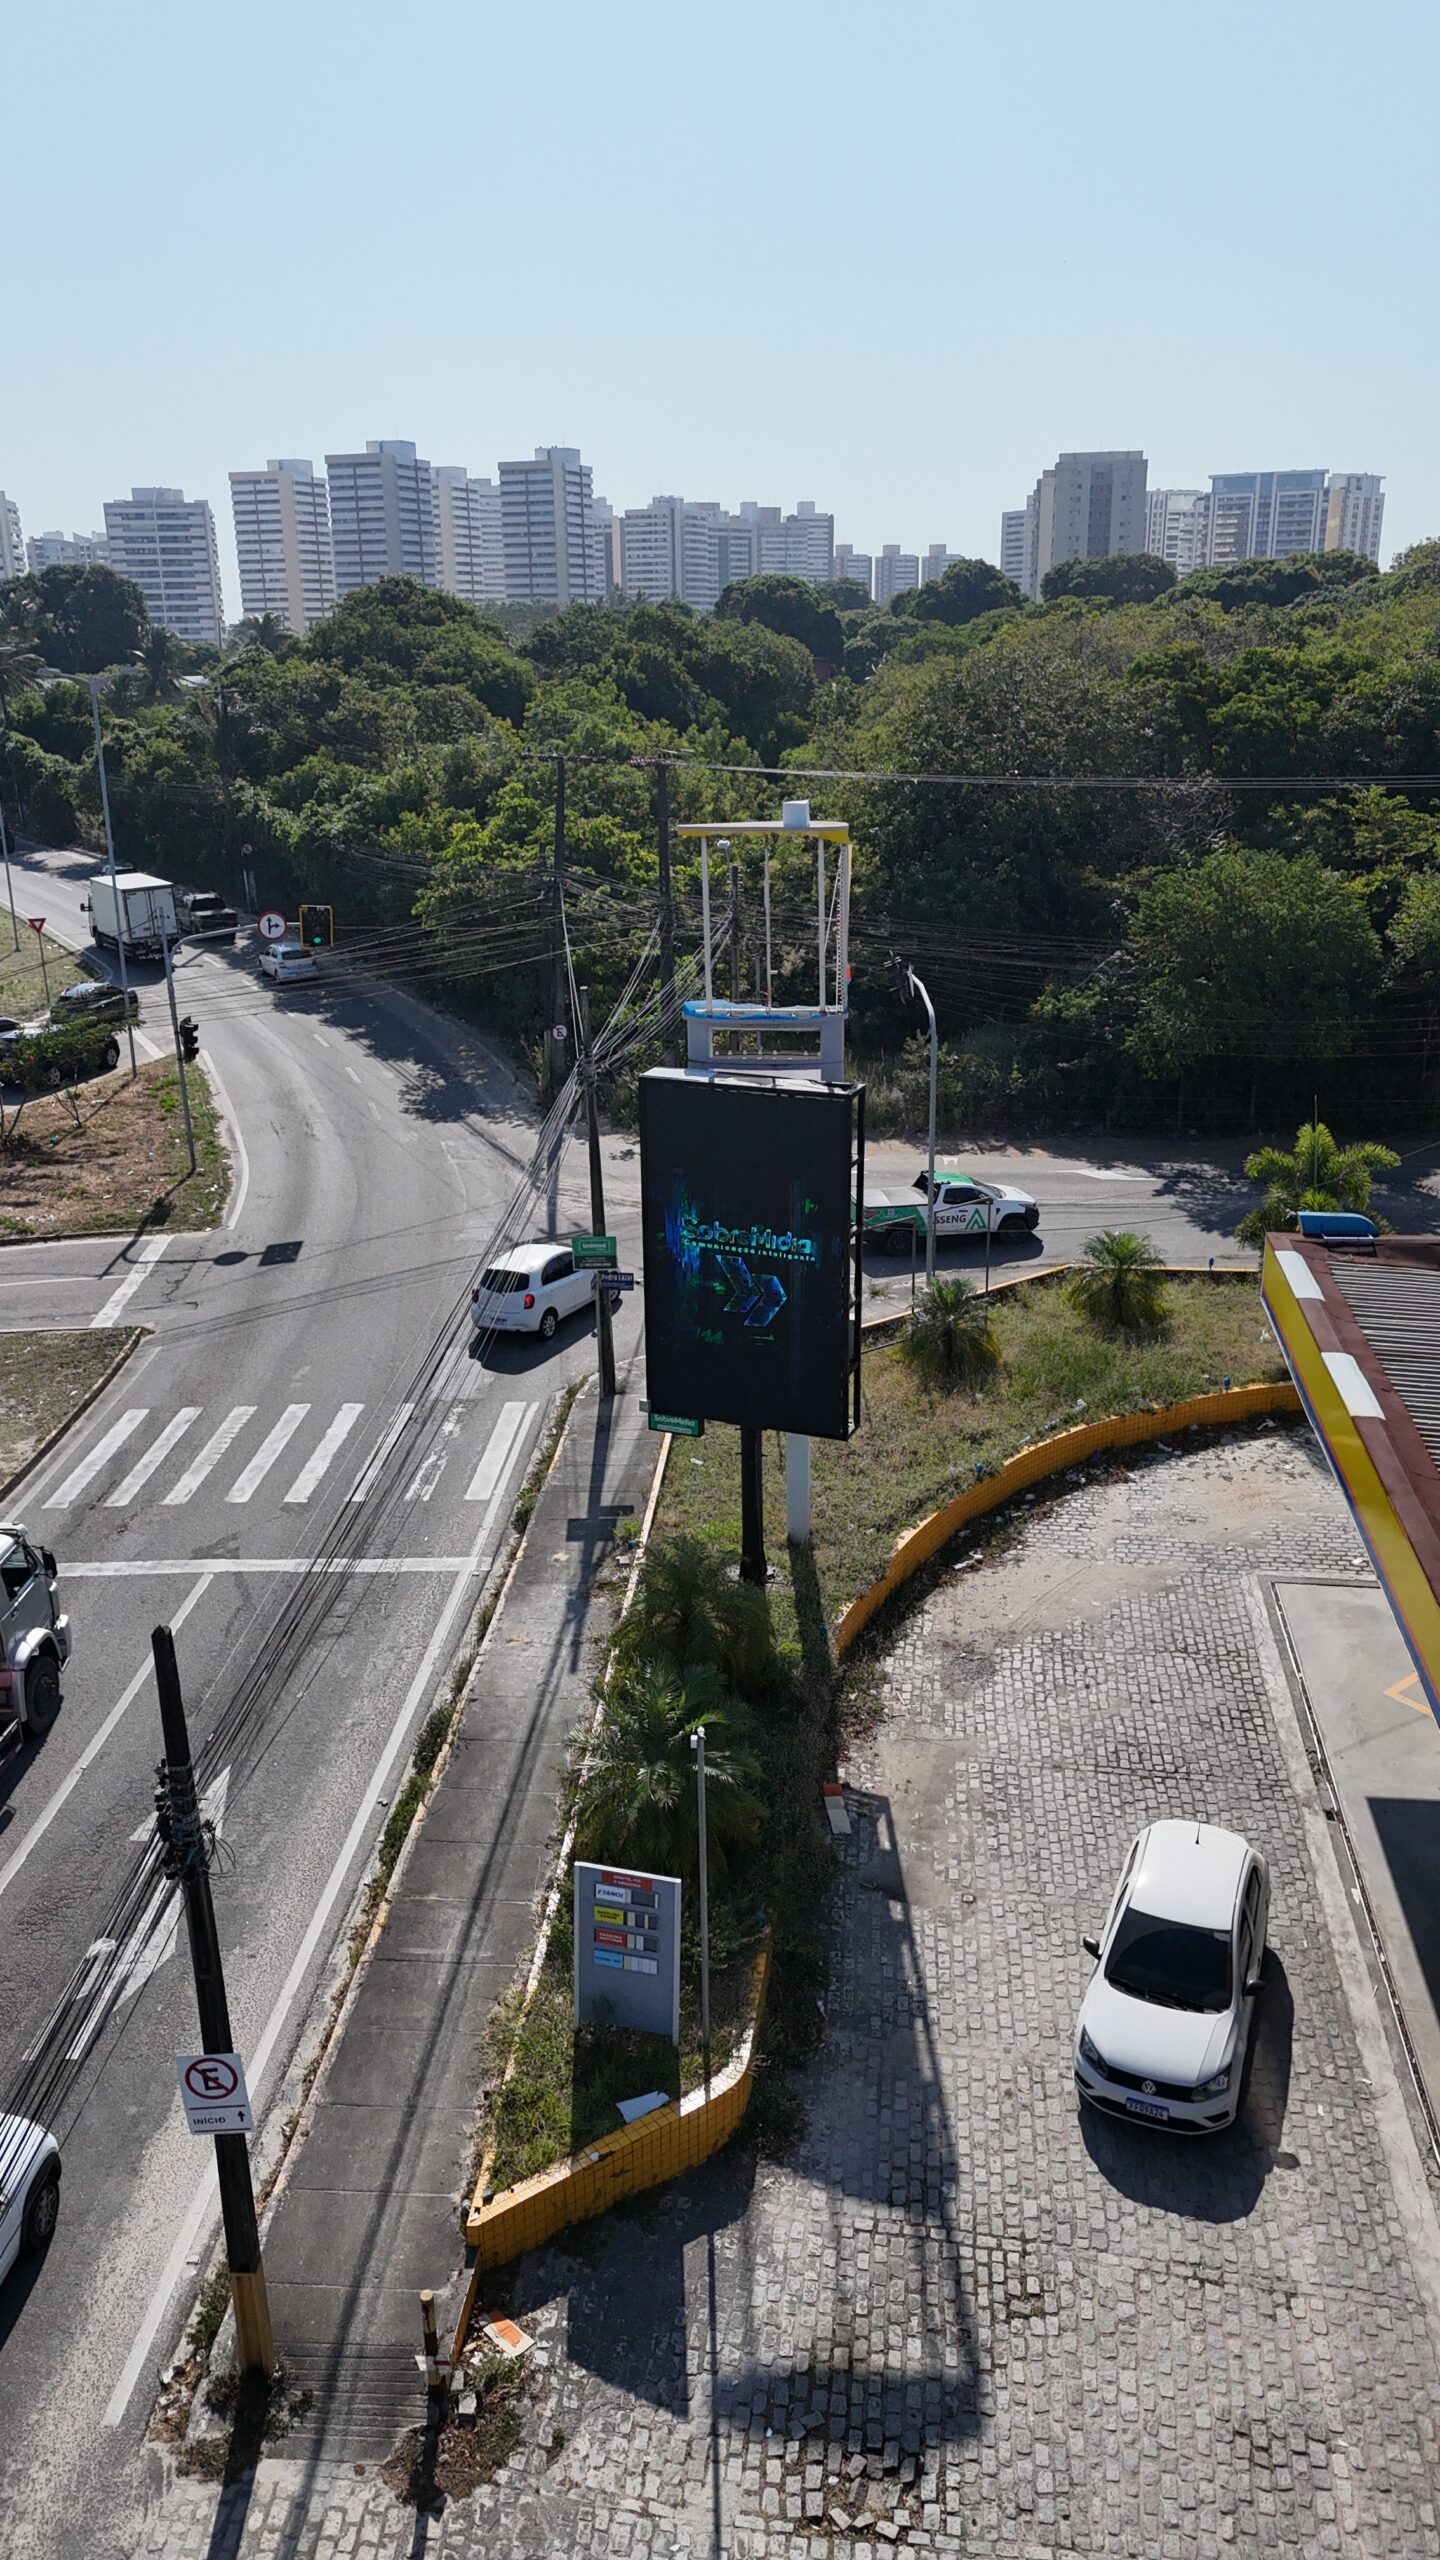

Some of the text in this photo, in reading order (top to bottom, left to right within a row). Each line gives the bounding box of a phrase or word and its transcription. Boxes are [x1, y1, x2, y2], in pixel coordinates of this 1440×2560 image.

[597, 1889, 624, 1899] ETANOL
[201, 2067, 222, 2091] E
[193, 2116, 226, 2125] INÍCIO
